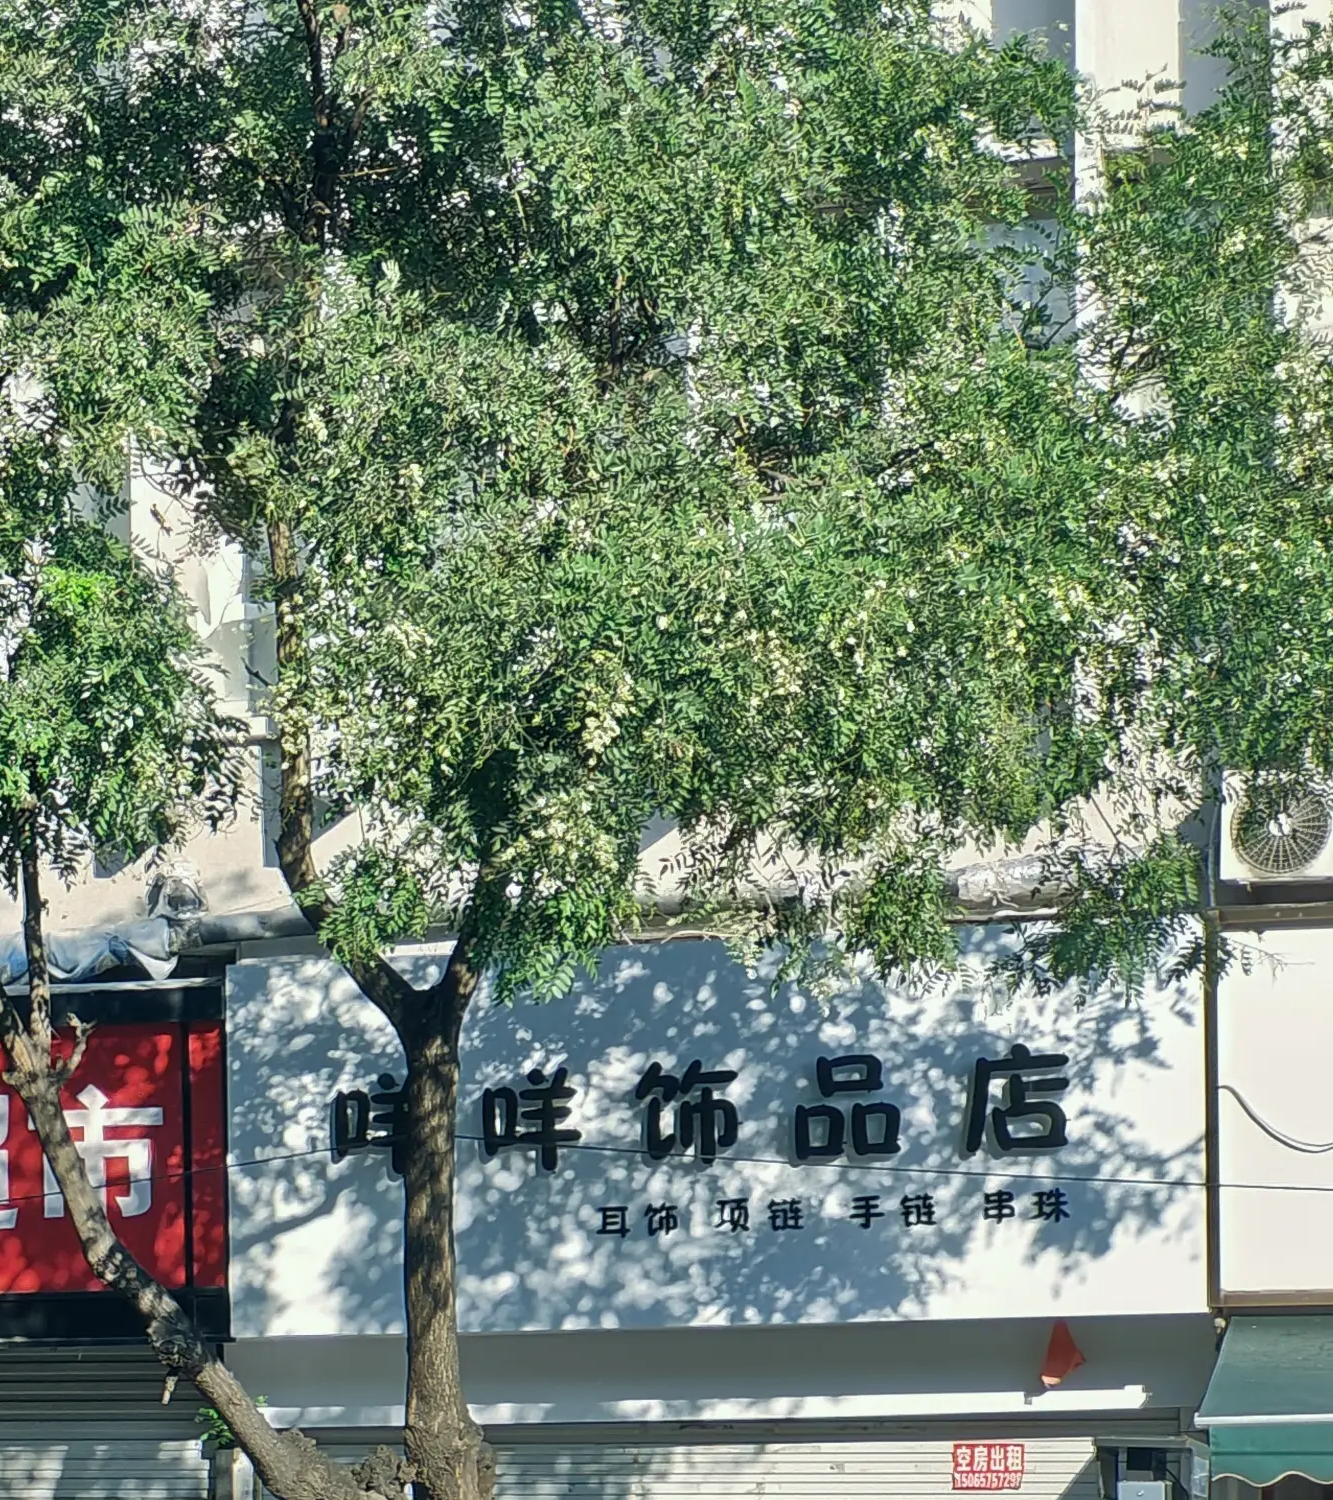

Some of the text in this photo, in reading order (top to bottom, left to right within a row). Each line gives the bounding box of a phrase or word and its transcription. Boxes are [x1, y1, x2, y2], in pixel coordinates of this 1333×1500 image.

[596, 1188, 1072, 1240] 耳饰 项链 手链 串珠
[956, 1445, 1023, 1472] 空房出租
